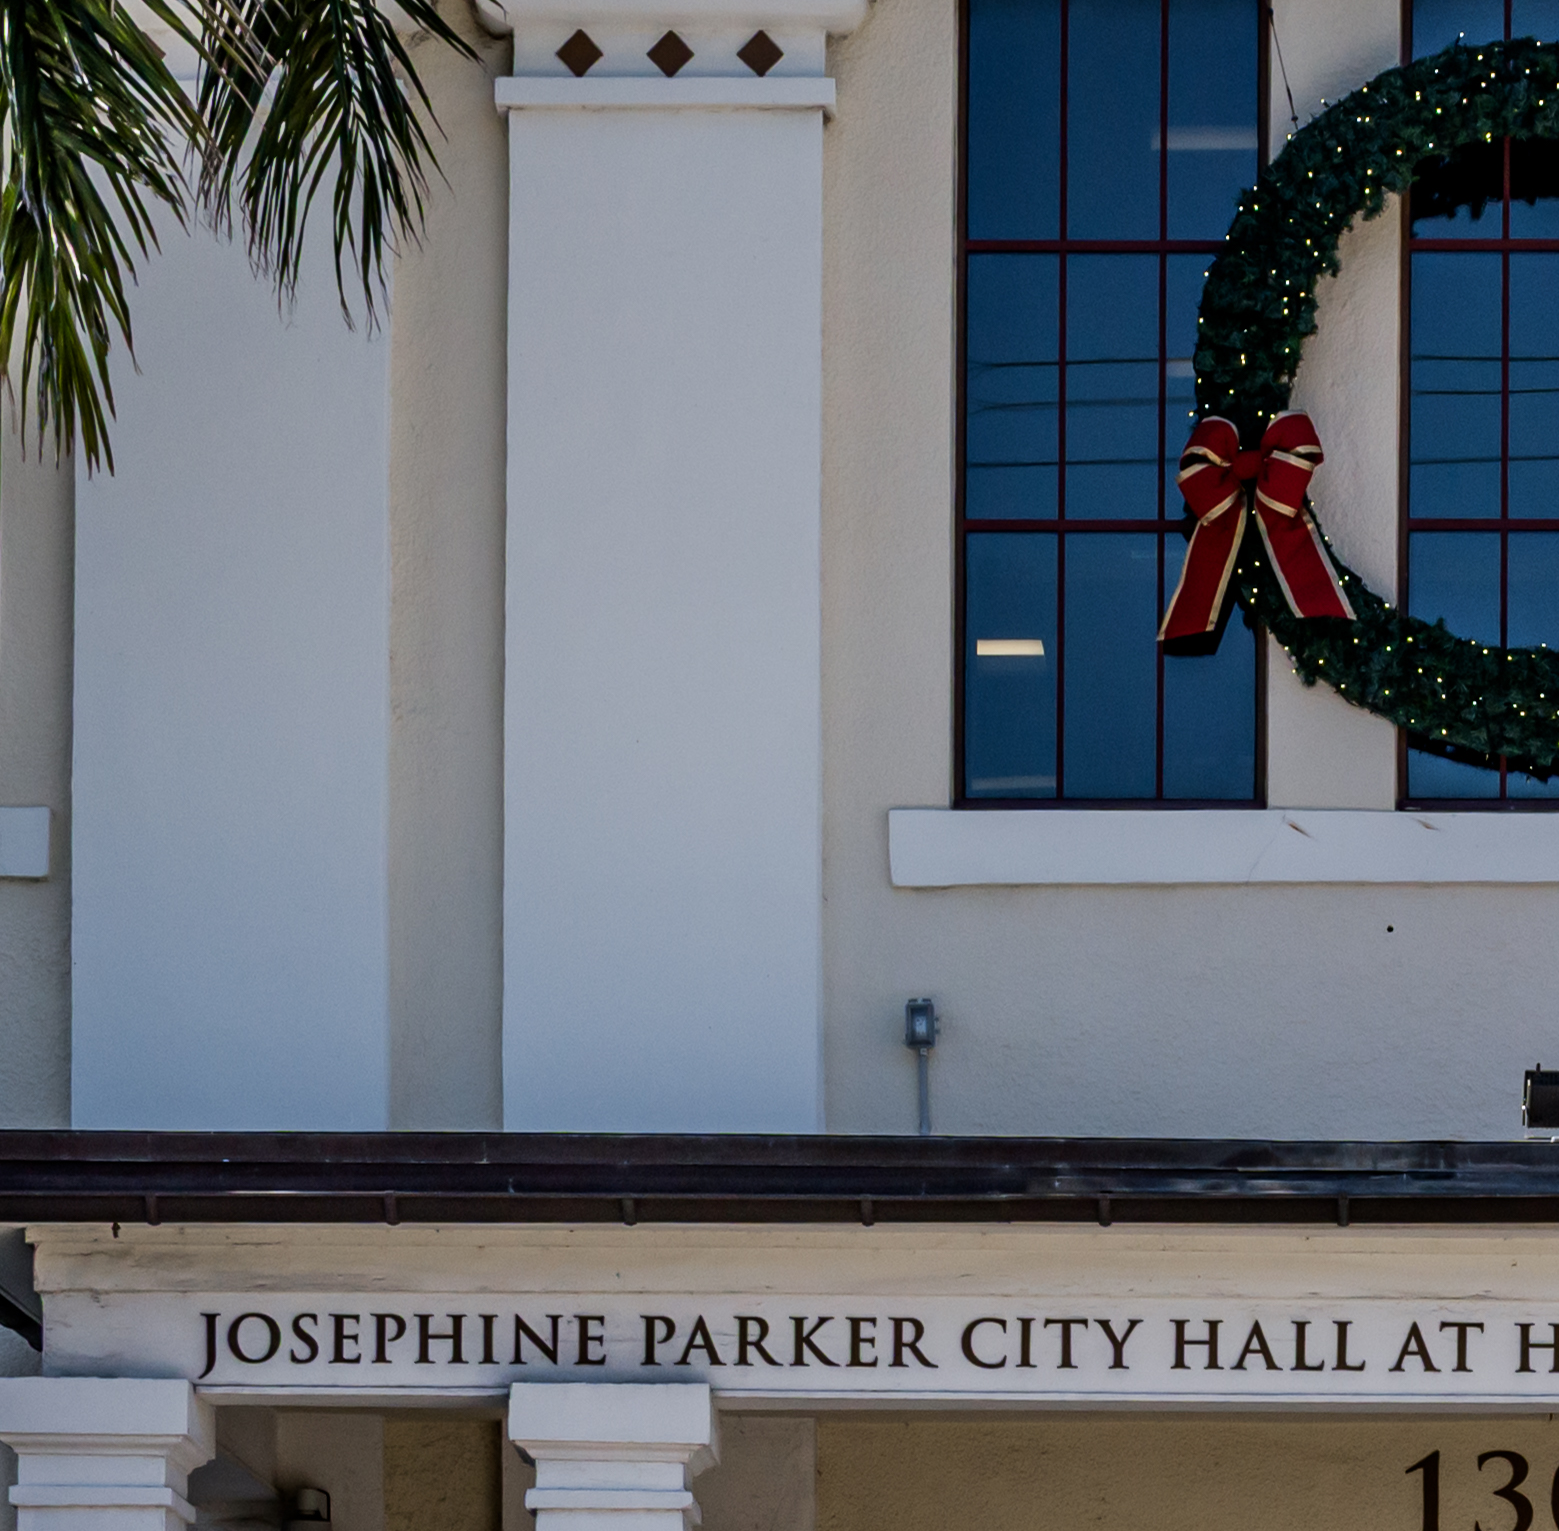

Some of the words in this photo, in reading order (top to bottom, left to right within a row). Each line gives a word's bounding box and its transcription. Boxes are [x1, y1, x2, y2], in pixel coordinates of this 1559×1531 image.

[197, 1312, 608, 1380] JOSEPHINE
[640, 1314, 939, 1369] PARKER
[961, 1317, 1144, 1370] CITY
[1169, 1319, 1366, 1372] HALL
[1388, 1321, 1486, 1373] AT
